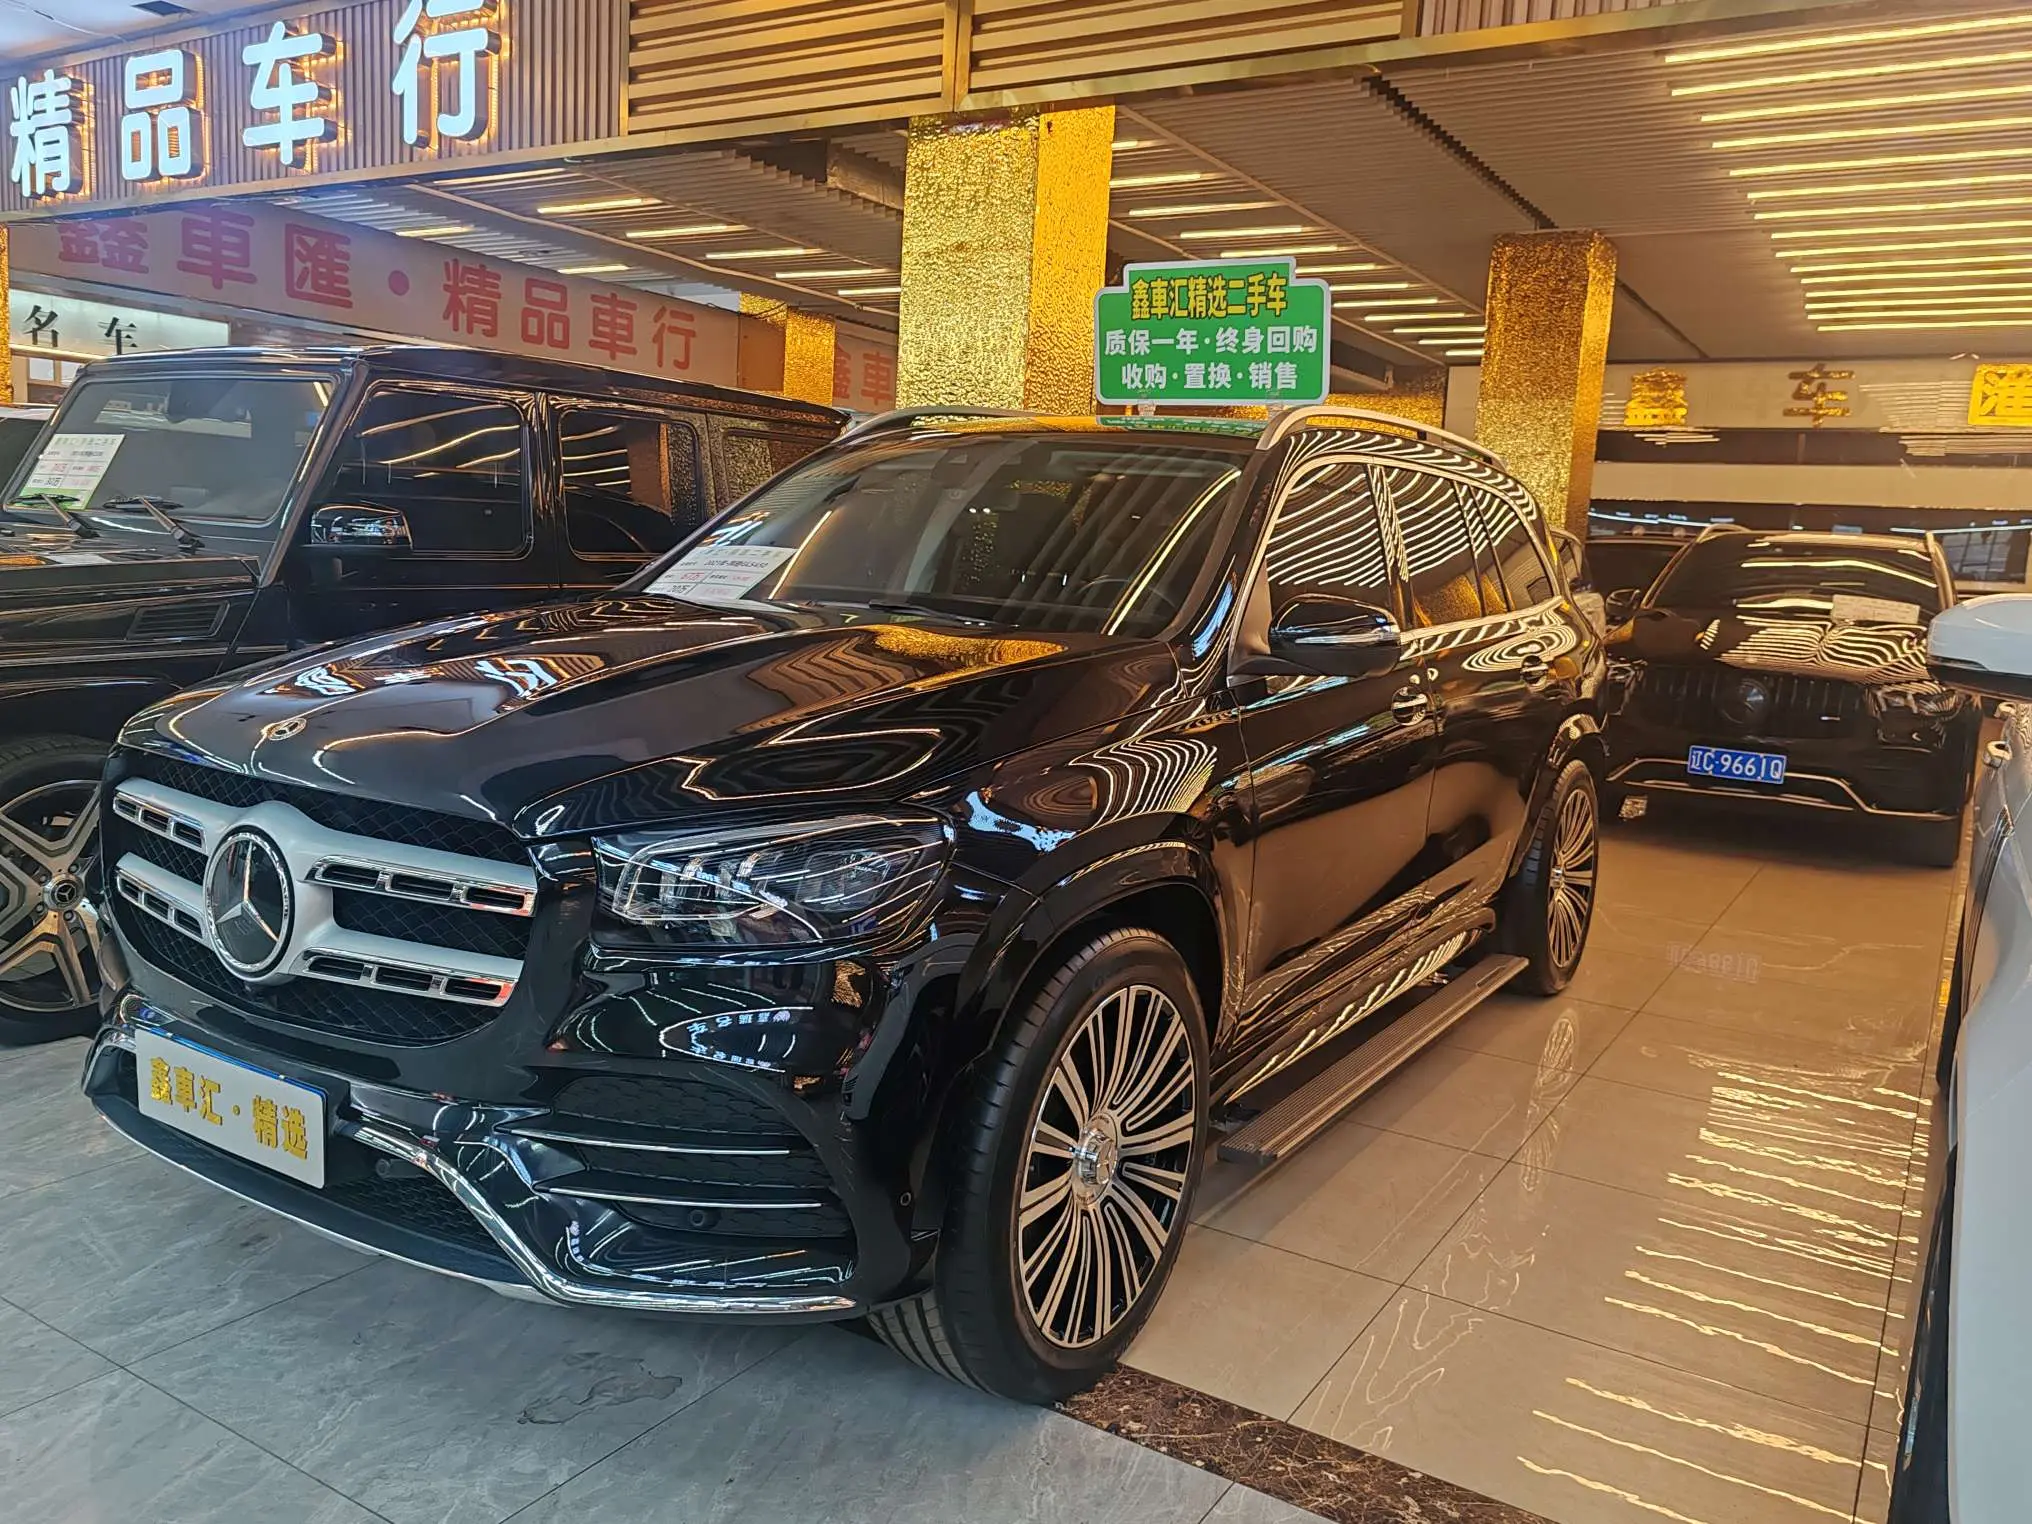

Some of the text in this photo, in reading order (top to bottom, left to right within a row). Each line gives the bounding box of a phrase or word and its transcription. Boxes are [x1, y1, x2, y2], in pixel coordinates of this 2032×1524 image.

[10, 0, 492, 198] 精品车行
[1131, 272, 1287, 320] 鑫車汇精选二手车
[1104, 325, 1318, 356] 质保一年·终身回购
[1121, 361, 1298, 390] 收购·置换·销售
[150, 1056, 308, 1160] 鑫車汇·精选
